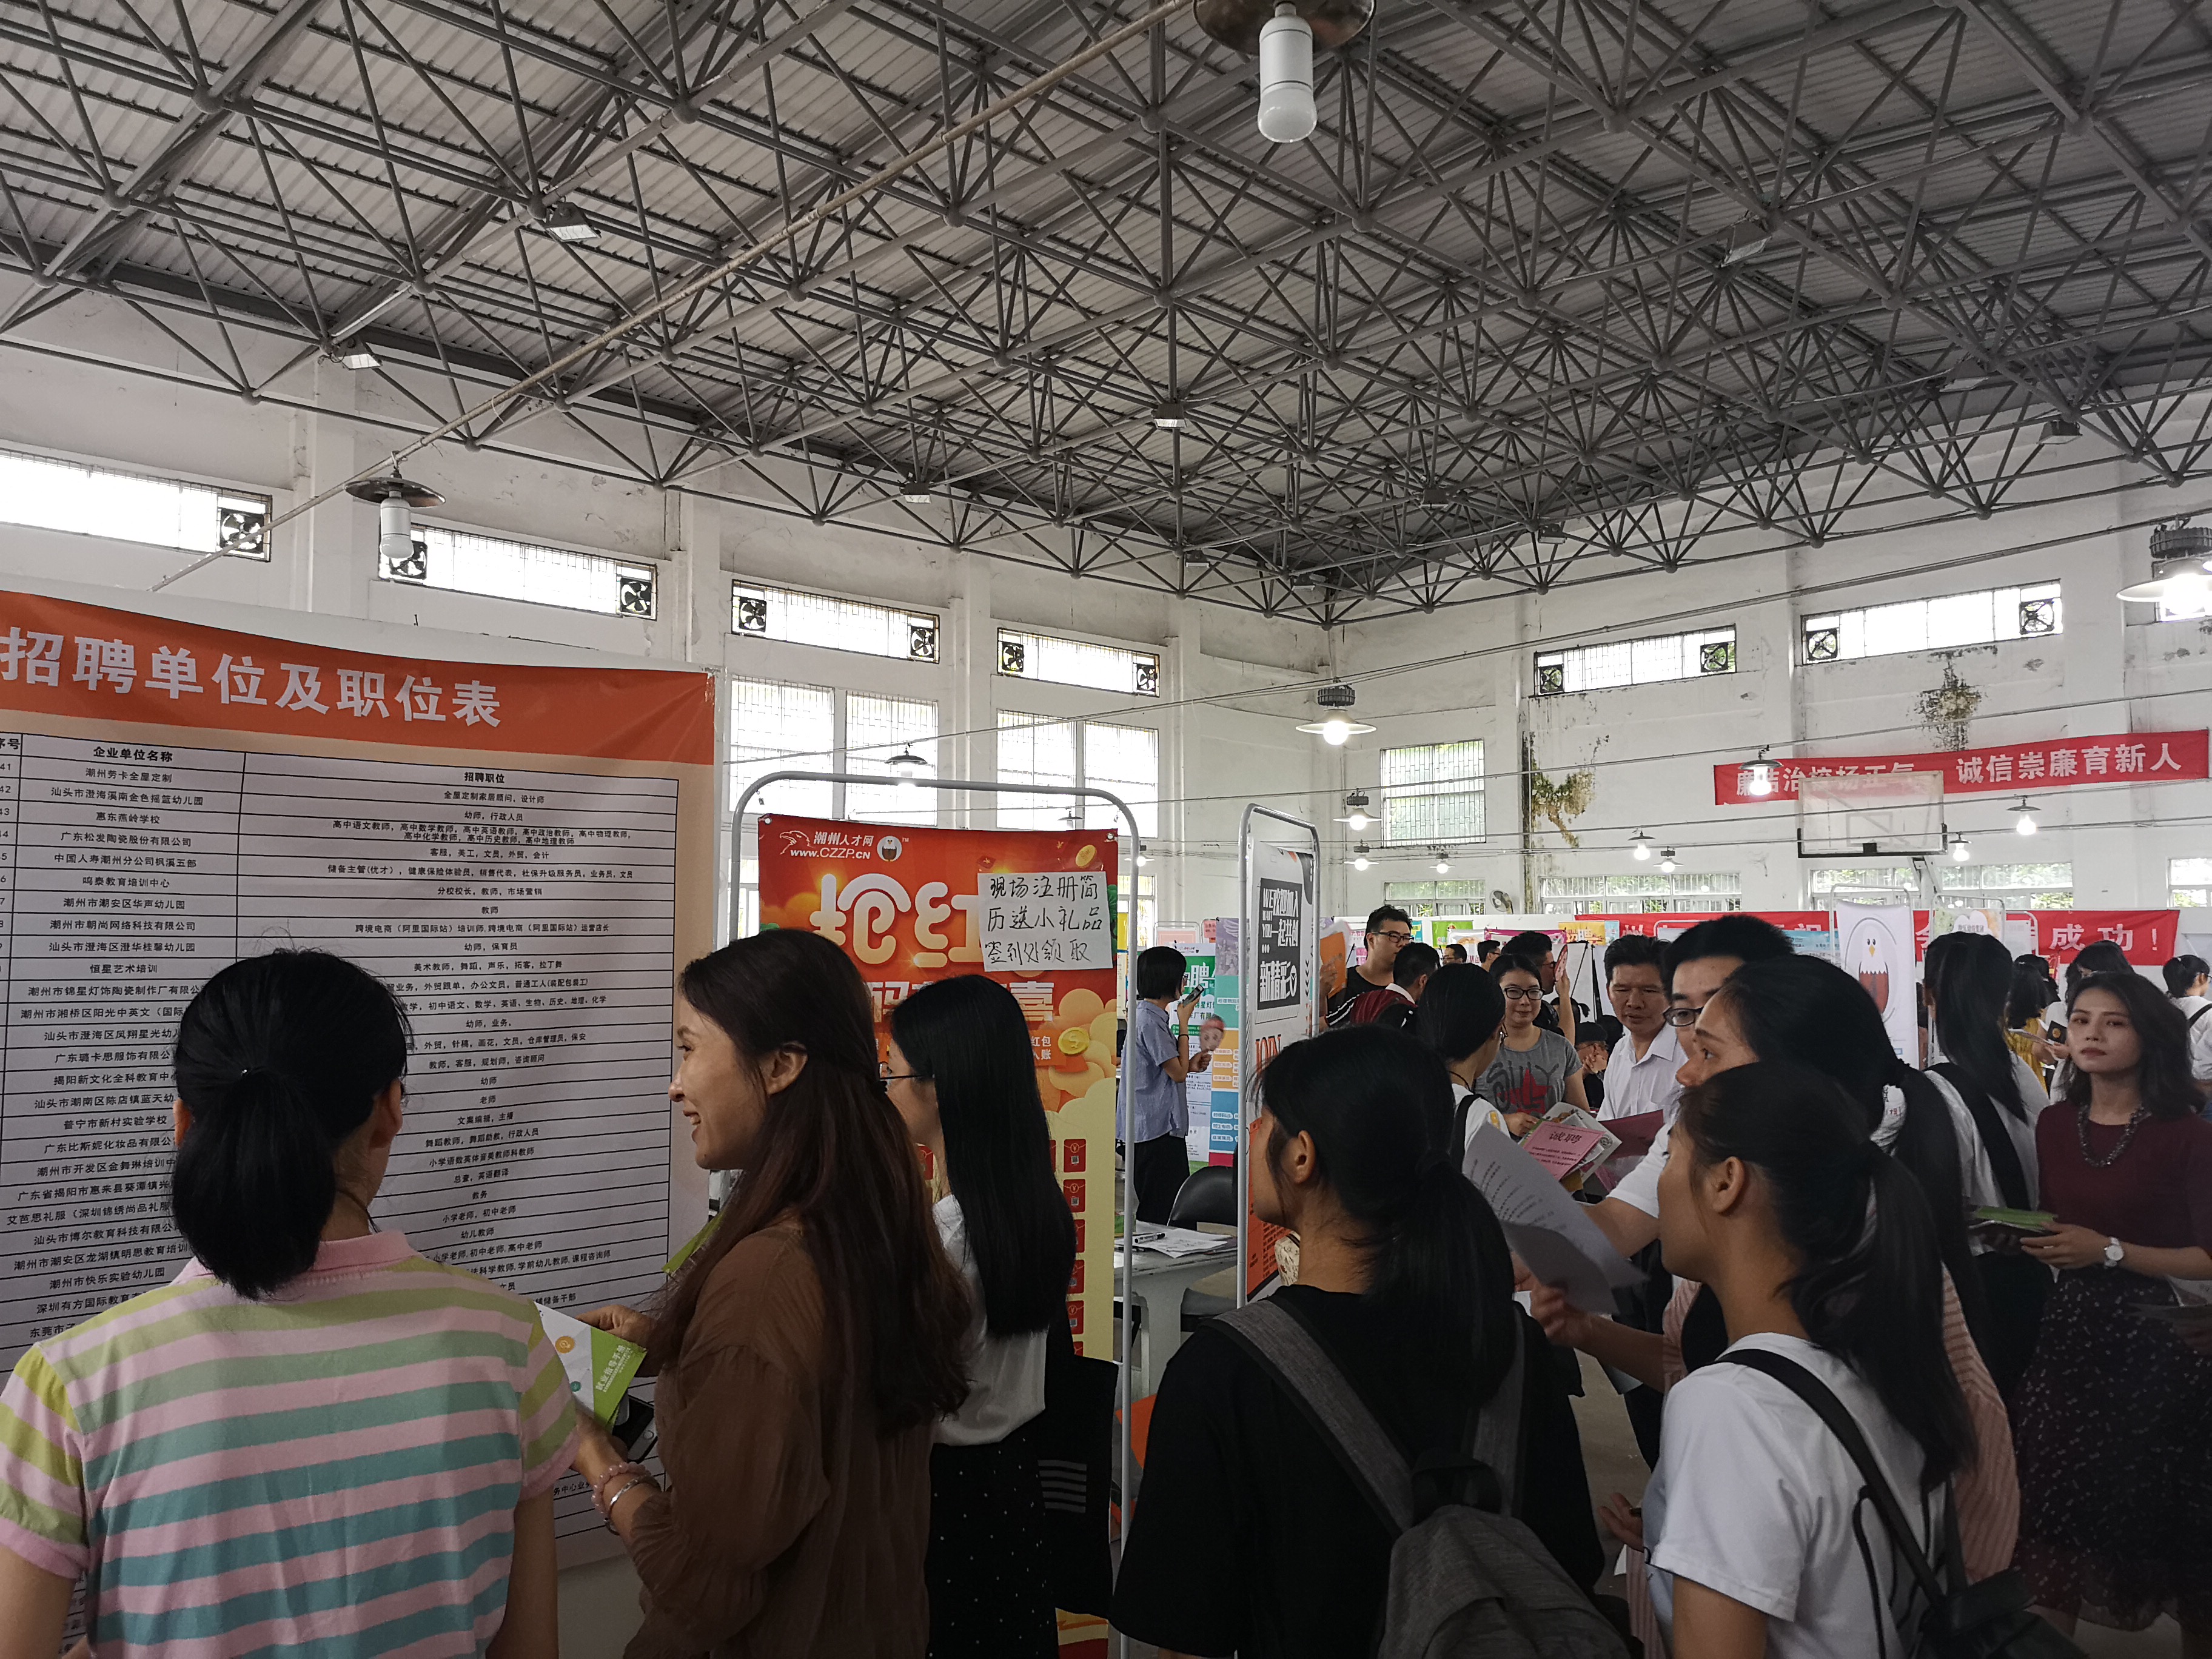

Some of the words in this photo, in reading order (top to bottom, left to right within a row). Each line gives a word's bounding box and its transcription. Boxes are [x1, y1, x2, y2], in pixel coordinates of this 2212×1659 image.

[0, 626, 501, 727] 招聘单位及职位表
[93, 746, 173, 762] 企业单位名称
[1957, 743, 2181, 783] 诚信崇廉育新人
[85, 768, 172, 783] 潮州劳卡全屋定制
[464, 772, 504, 783] 招聘职位
[51, 787, 204, 806] 汕头市澄海溪南金色摇篮幼儿园
[96, 812, 160, 825] 惠东燕岭学校
[61, 831, 192, 847] 广东松发陶瓷股份有限公司
[814, 831, 874, 846] 潮州人才网
[791, 847, 871, 859] www.CZZP.CN
[54, 853, 197, 869] 中国人寿潮州分公司枫溪五部
[990, 875, 1098, 901] 现场注册简
[63, 897, 186, 910] 潮州市潮安区华声幼儿园
[50, 919, 196, 931] 潮州市朝尚网络科技有限公司
[988, 906, 1102, 932] 历送小礼品
[1262, 923, 1272, 937] YOU
[49, 942, 196, 953] 汕头市澄海区澄华桂馨幼儿园
[90, 964, 158, 974] 恒星艺术培训
[28, 984, 206, 997] 潮州市锦星灯饰陶瓷制作厂有限公
[55, 1050, 176, 1064] 广东璐卡思服饰有限公
[480, 1076, 497, 1085] 幼师
[480, 1095, 496, 1104] 老师
[64, 1115, 167, 1130] 普宁市新村实验学校
[44, 1136, 174, 1154] 广东比斯妮化妆品有限公
[34, 1222, 177, 1245] 汕头市博尔教育科技有限公
[50, 1267, 166, 1290] 潮州市快乐实验幼儿园
